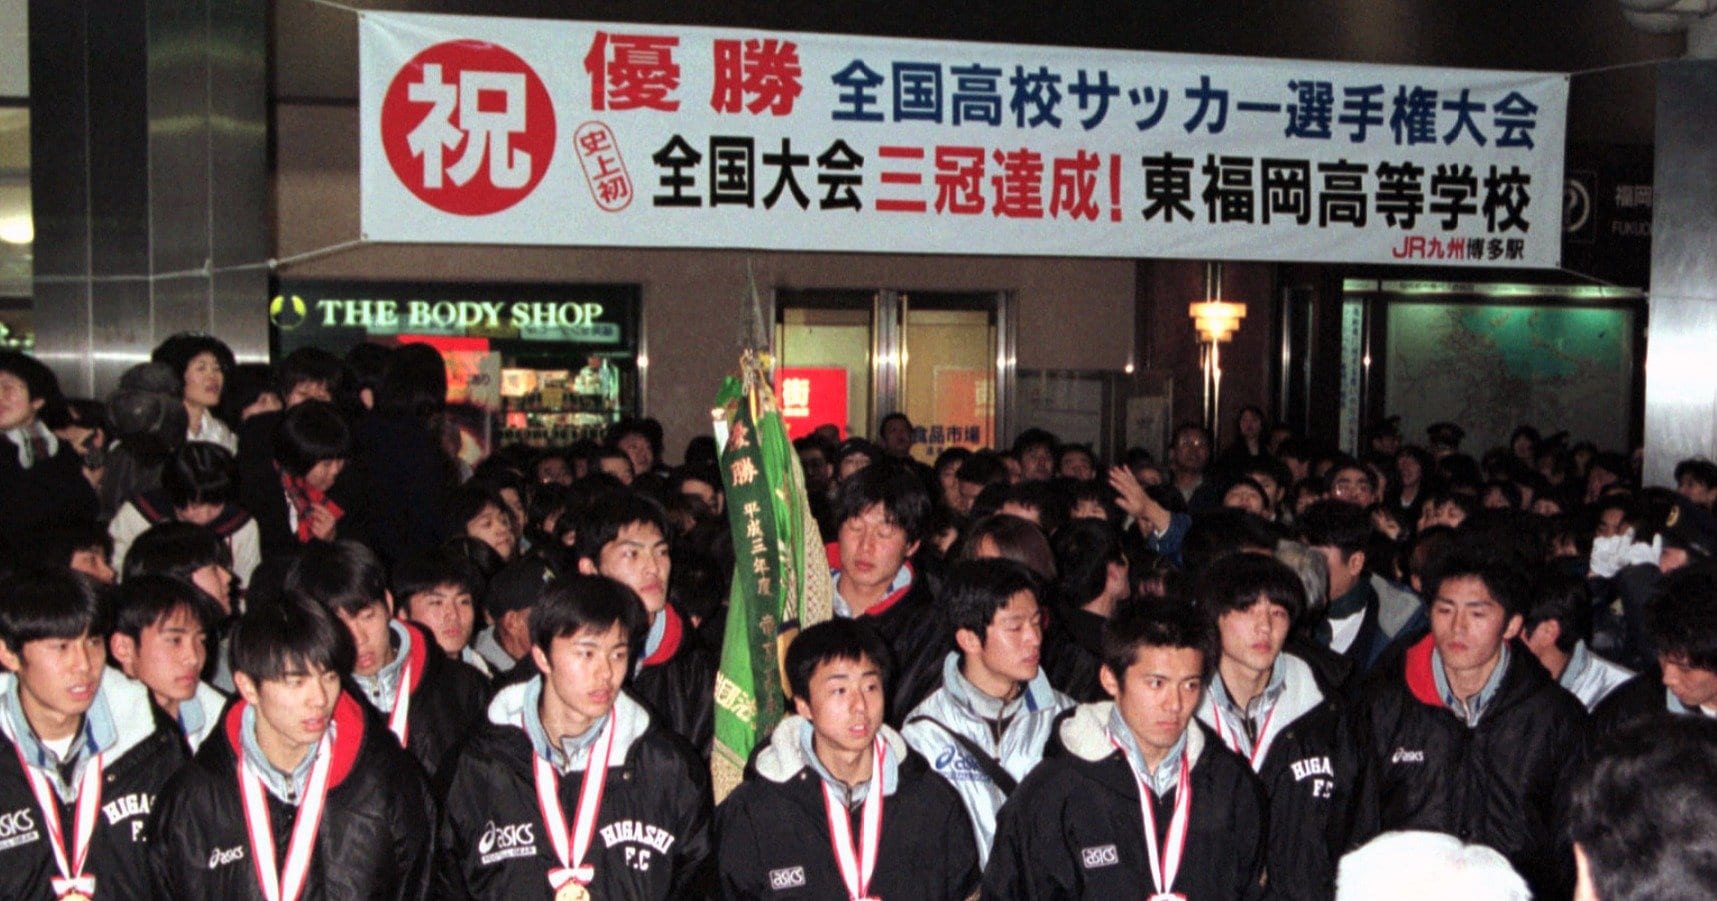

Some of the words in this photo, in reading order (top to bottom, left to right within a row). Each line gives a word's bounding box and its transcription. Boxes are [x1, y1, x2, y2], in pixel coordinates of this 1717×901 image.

[406, 62, 533, 191] 祝
[583, 31, 804, 117] 優勝
[831, 58, 1538, 150] 全国高校サッカー選手権大会
[581, 130, 629, 203] 史上初
[1141, 151, 1532, 232] 東福岡高等学校
[1392, 236, 1525, 262] JR九州博多駅
[317, 299, 399, 327] THE
[407, 301, 502, 328] BODY
[511, 302, 604, 328] SHOP
[600, 819, 675, 855] HIGASHI
